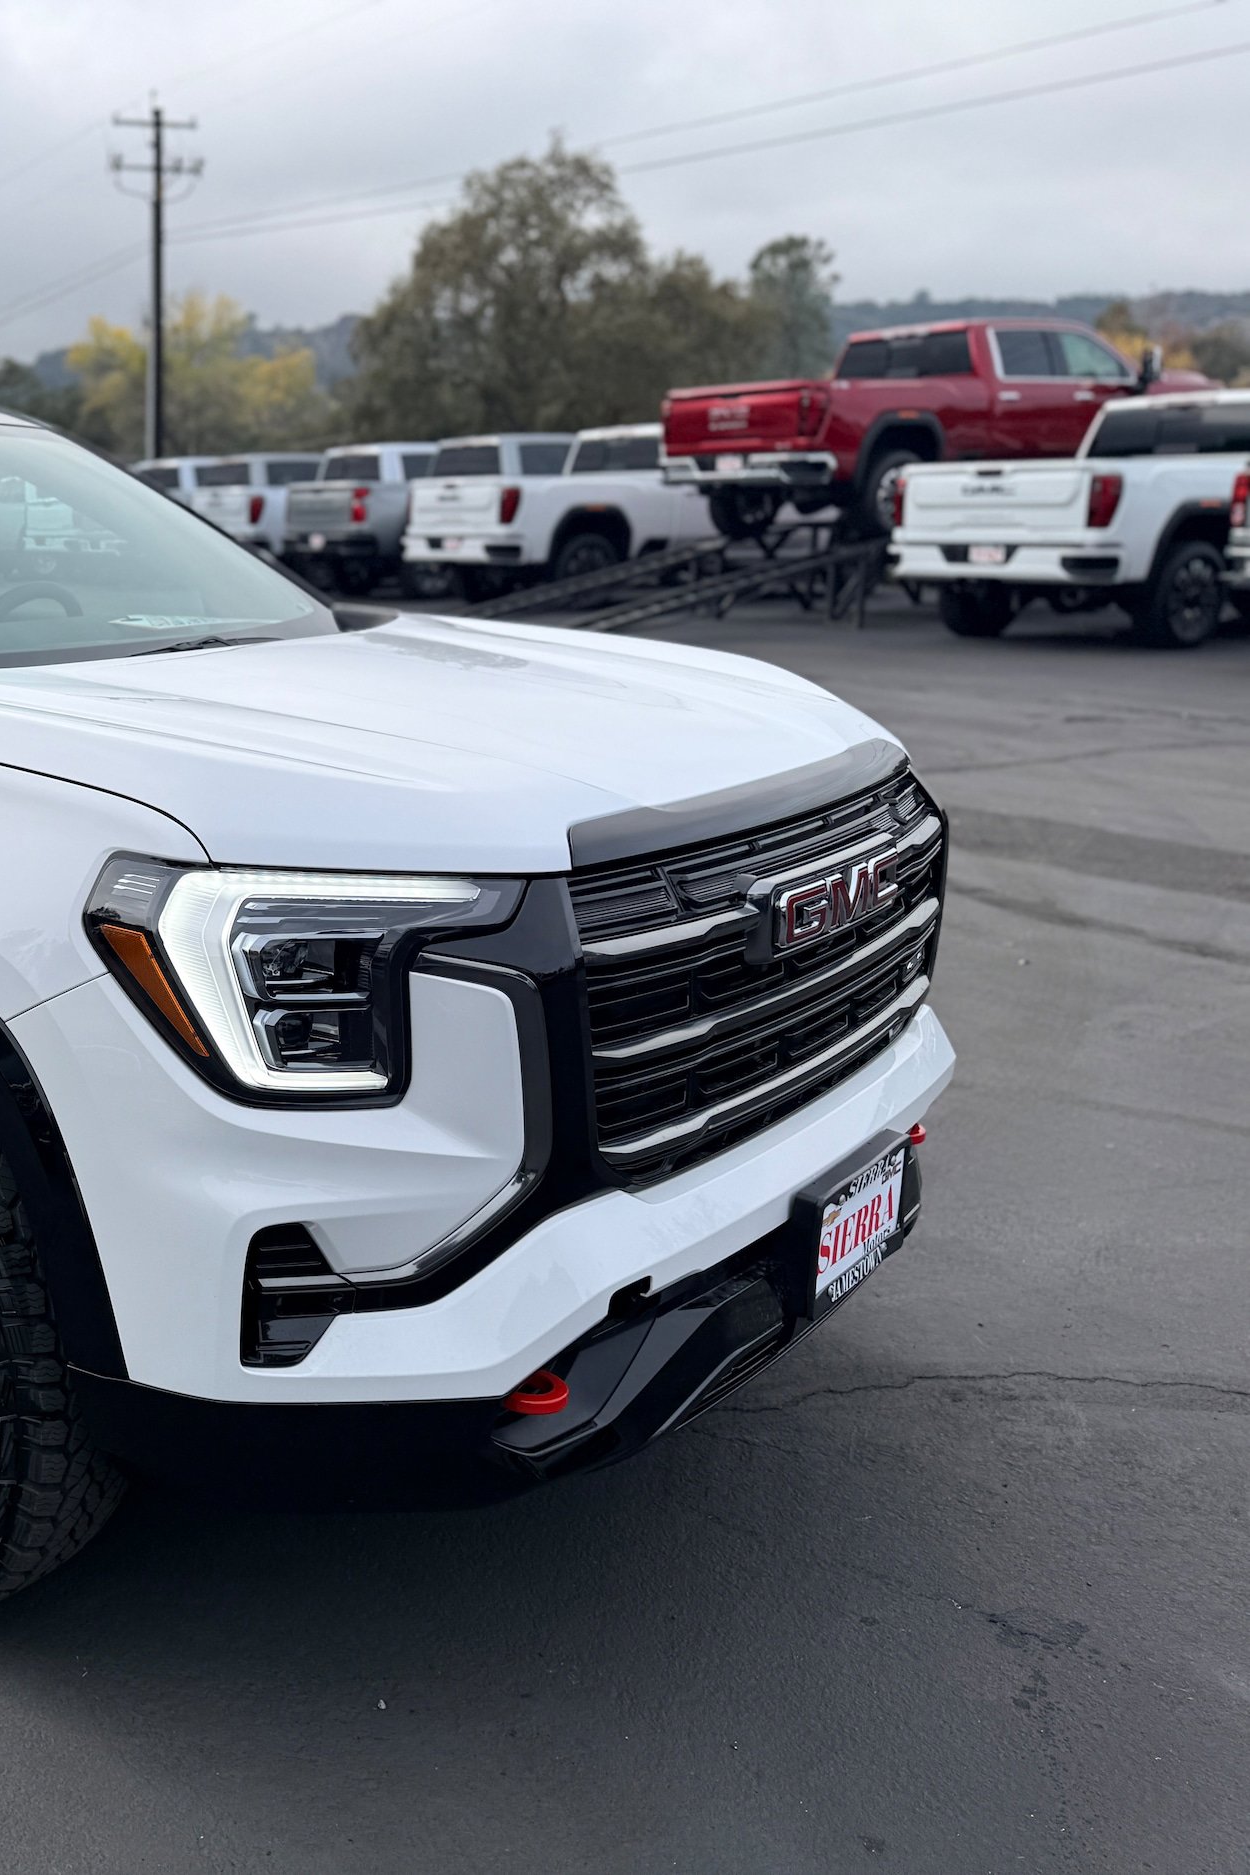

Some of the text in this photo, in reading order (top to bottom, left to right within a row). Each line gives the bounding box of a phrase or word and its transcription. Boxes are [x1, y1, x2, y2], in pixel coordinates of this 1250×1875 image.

[779, 848, 900, 947] GMC
[848, 1154, 893, 1200] SIERRA
[881, 1161, 902, 1184] GMC
[817, 1184, 895, 1276] SIERRA
[862, 1225, 892, 1256] Motors
[830, 1247, 884, 1303] JAMESTOWN
